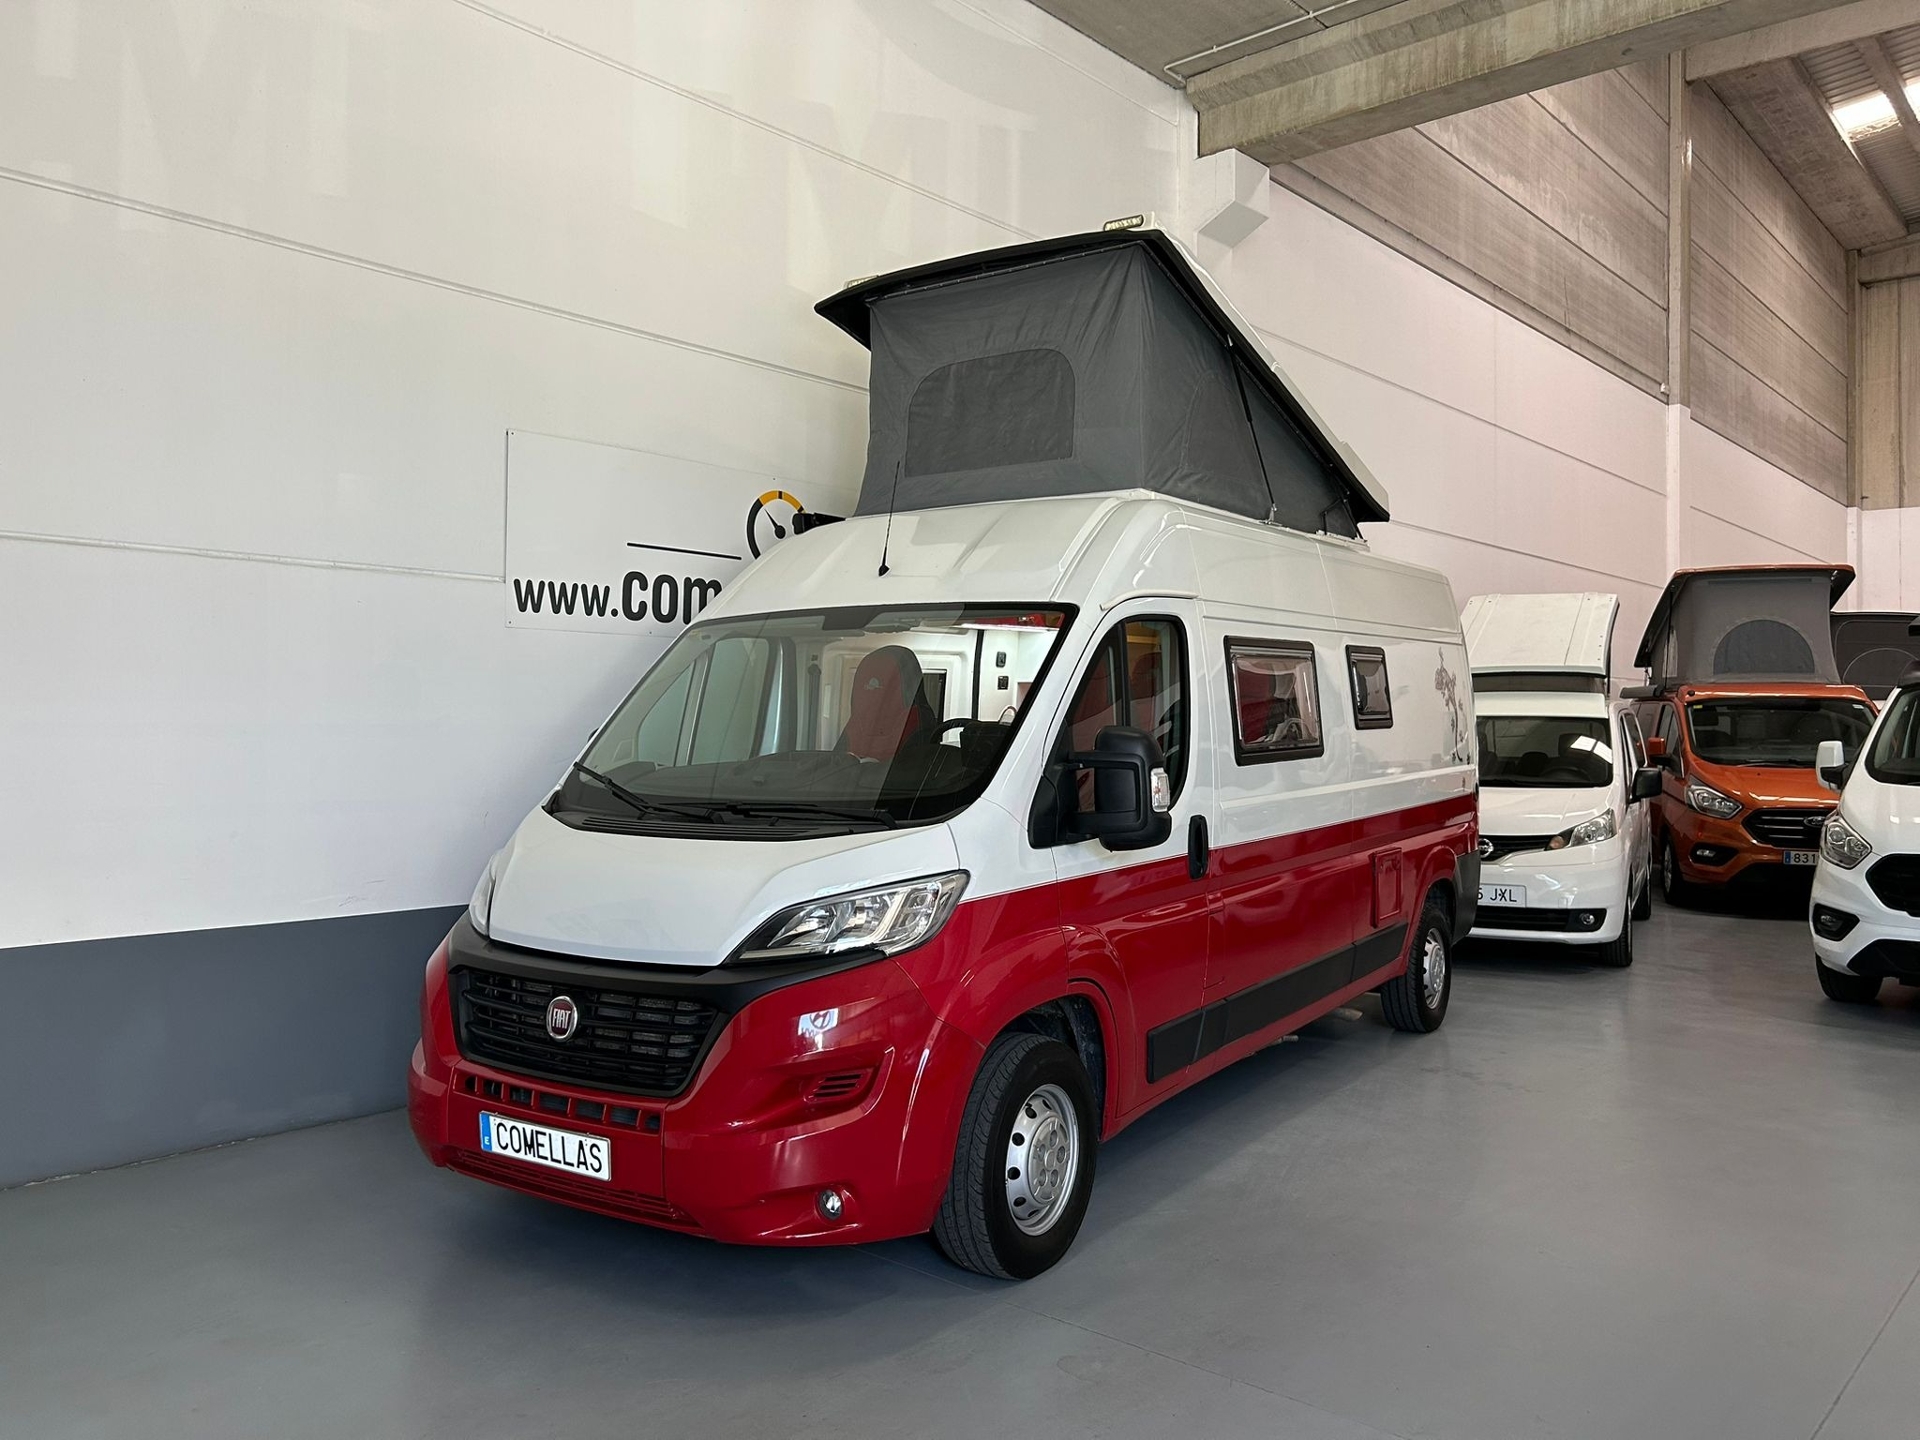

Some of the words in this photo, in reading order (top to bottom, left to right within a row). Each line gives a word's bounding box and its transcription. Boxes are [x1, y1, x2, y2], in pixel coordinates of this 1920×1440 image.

[1490, 888, 1517, 902] JXL
[552, 1008, 571, 1029] FIAT
[496, 1122, 603, 1173] COMELLAS
